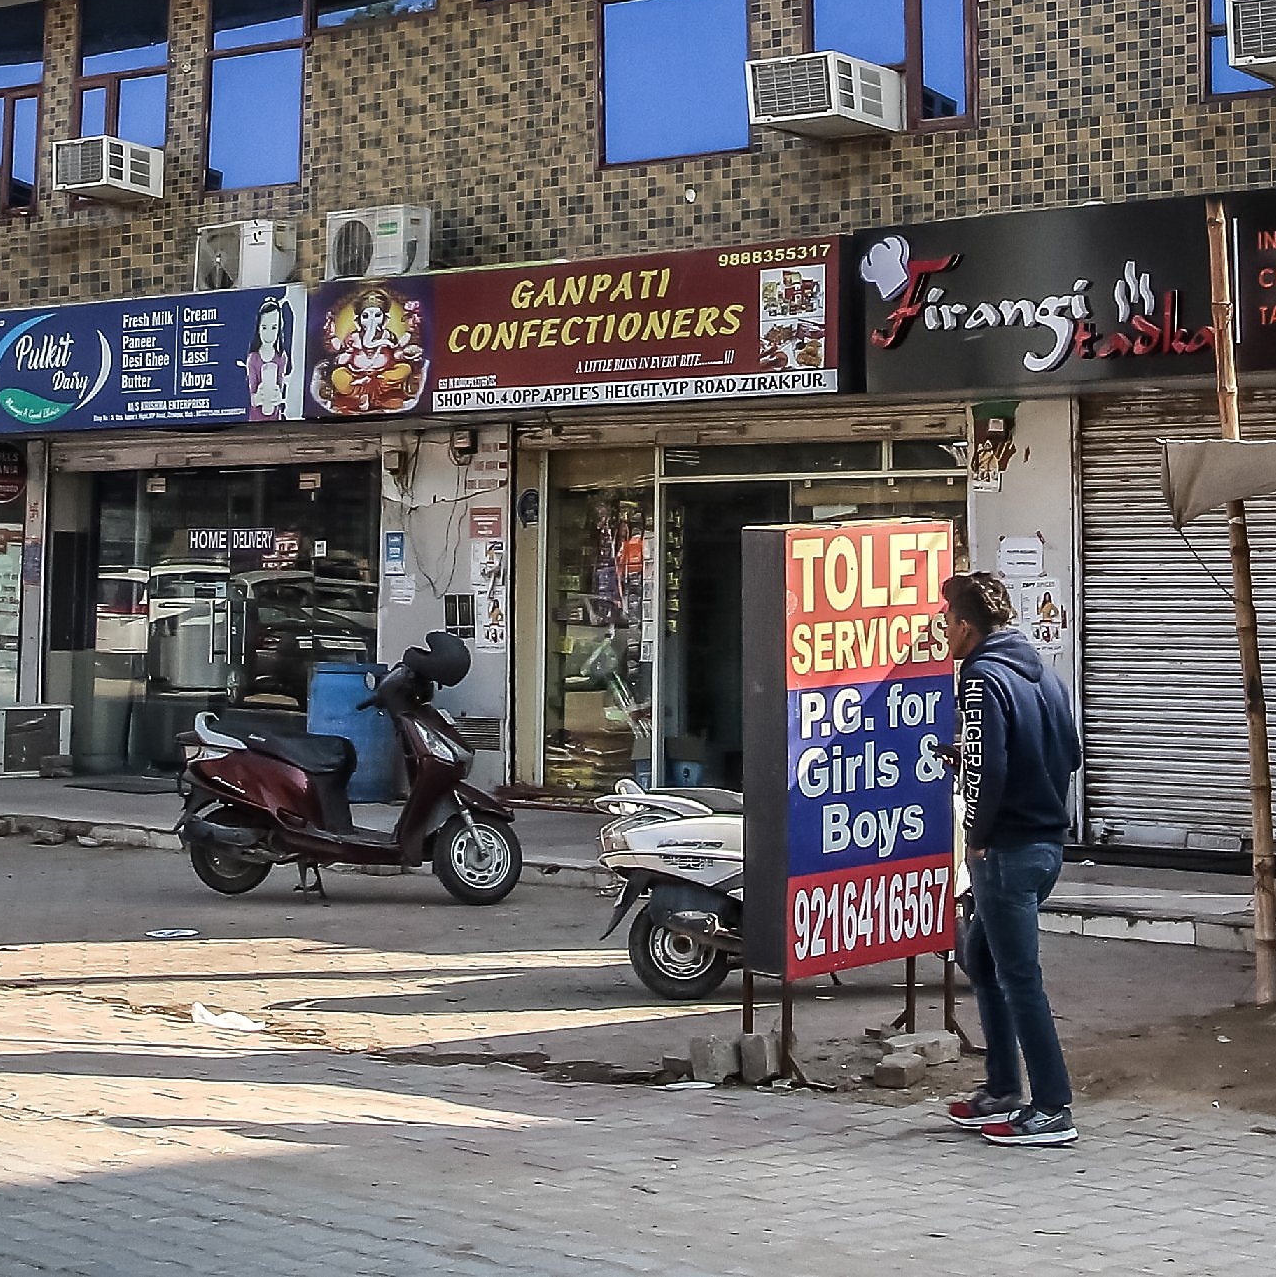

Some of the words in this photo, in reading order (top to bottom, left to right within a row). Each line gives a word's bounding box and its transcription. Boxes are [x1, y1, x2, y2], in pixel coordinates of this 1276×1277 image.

[718, 244, 832, 268] 9888355317
[511, 267, 671, 310] GANPATI
[122, 314, 150, 329] Fresh
[152, 310, 174, 326] Milk
[183, 307, 218, 323] Cream
[183, 329, 209, 346] Curd
[448, 304, 745, 353] CONFECTIONERS
[16, 332, 75, 371] Pulkit
[122, 335, 157, 350] Paneer
[122, 353, 145, 368] Desi
[146, 352, 171, 367] Ghee
[182, 348, 210, 365] Lassi
[576, 361, 582, 373] A
[584, 359, 613, 373] LITTLE
[613, 357, 637, 371] BLISS
[638, 357, 651, 370] IN
[650, 354, 680, 369] EVERY
[52, 371, 90, 400] Dairy
[121, 374, 153, 390] Butter
[181, 372, 214, 390] Khoya
[437, 391, 471, 407] SHOP
[189, 530, 227, 550] HOME
[232, 530, 273, 550] DELIVERY
[791, 531, 949, 613] TOLET
[791, 612, 950, 675] SERVICES
[800, 687, 875, 741] P.G.
[886, 683, 943, 729] for
[964, 678, 985, 767] HILFIGER
[797, 740, 901, 798] Girls
[915, 733, 946, 784] &
[821, 803, 925, 858] Boys
[793, 866, 951, 962] 9216416567
